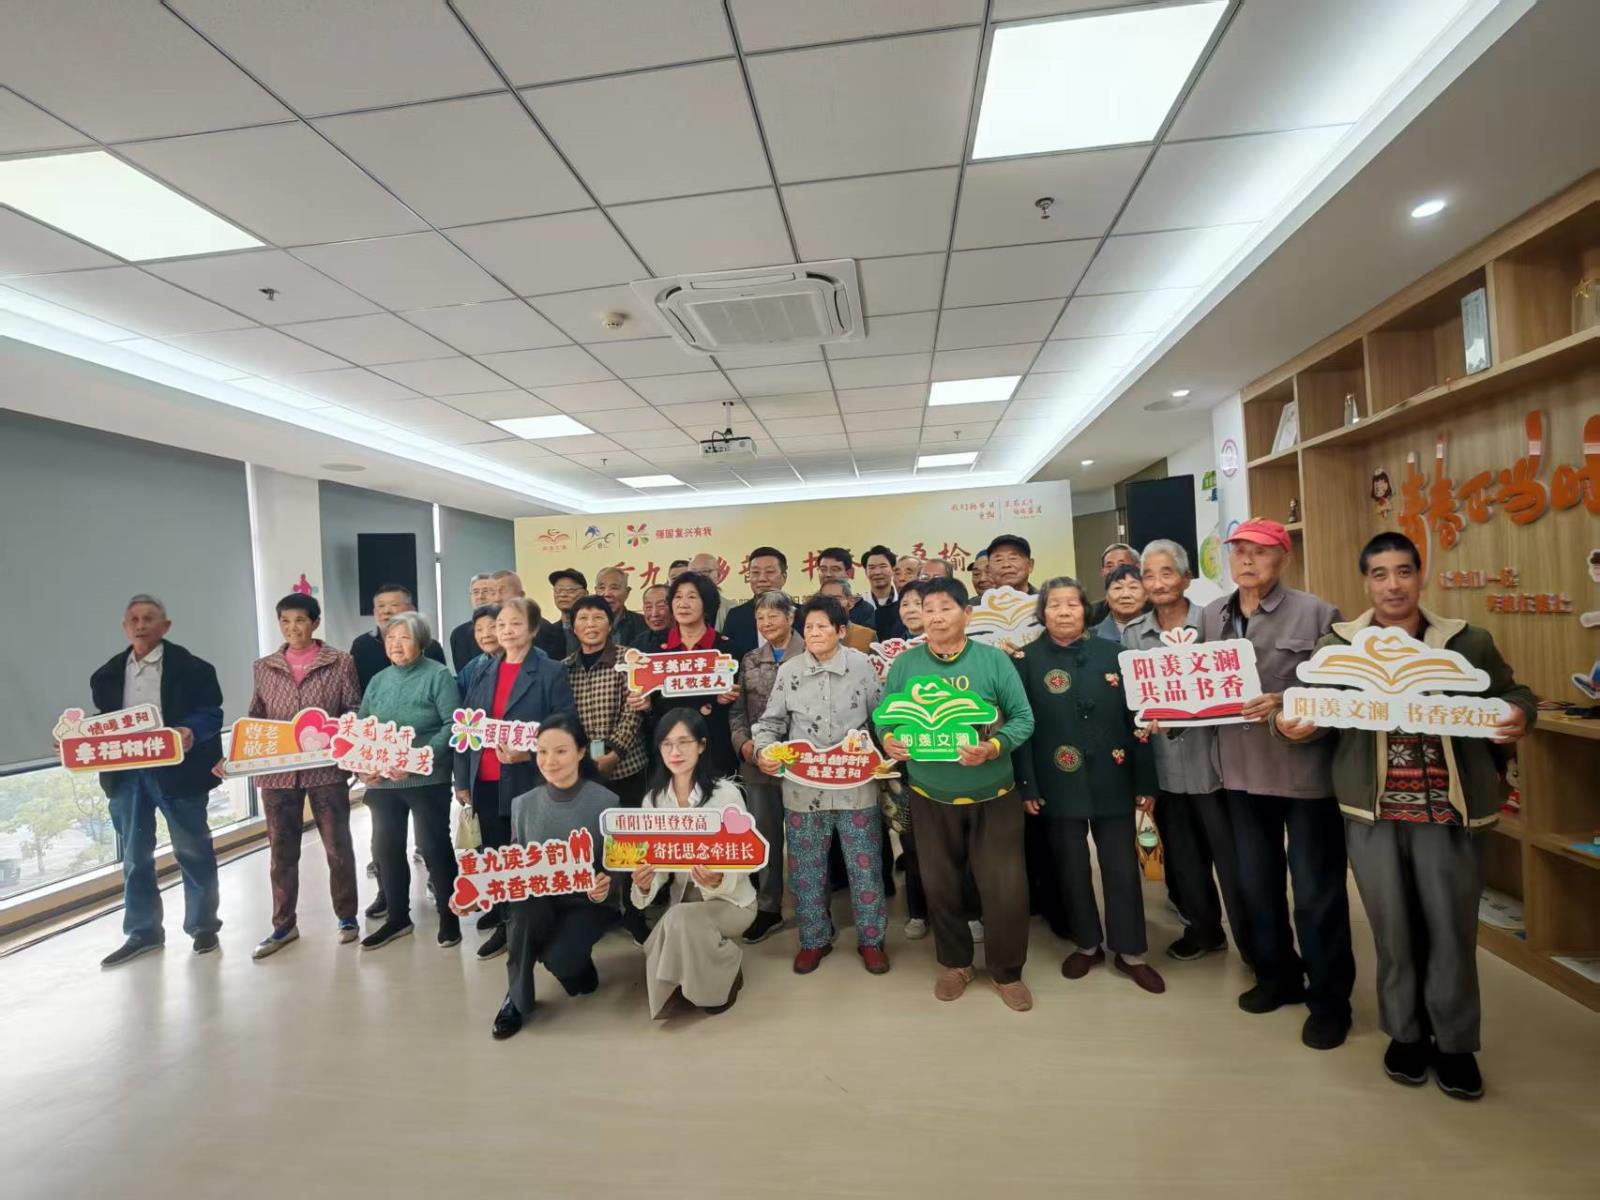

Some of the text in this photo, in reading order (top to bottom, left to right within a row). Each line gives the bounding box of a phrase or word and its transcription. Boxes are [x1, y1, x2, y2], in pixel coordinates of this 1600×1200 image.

[1132, 648, 1241, 681] 阳羡文澜
[1136, 674, 1244, 704] 共品书香
[1294, 697, 1500, 728] 阳羡文澜 书香致远
[245, 723, 279, 740] 尊老
[342, 716, 412, 745] 茉莉花开
[75, 736, 165, 764] 幸福相伴
[243, 741, 278, 757] 敬老
[615, 813, 708, 831] 重阳节里登登高
[459, 842, 567, 875] 重九读乡韵
[653, 842, 754, 860] 寄托思念牵挂长
[486, 868, 594, 900] 书香敬桑榆
